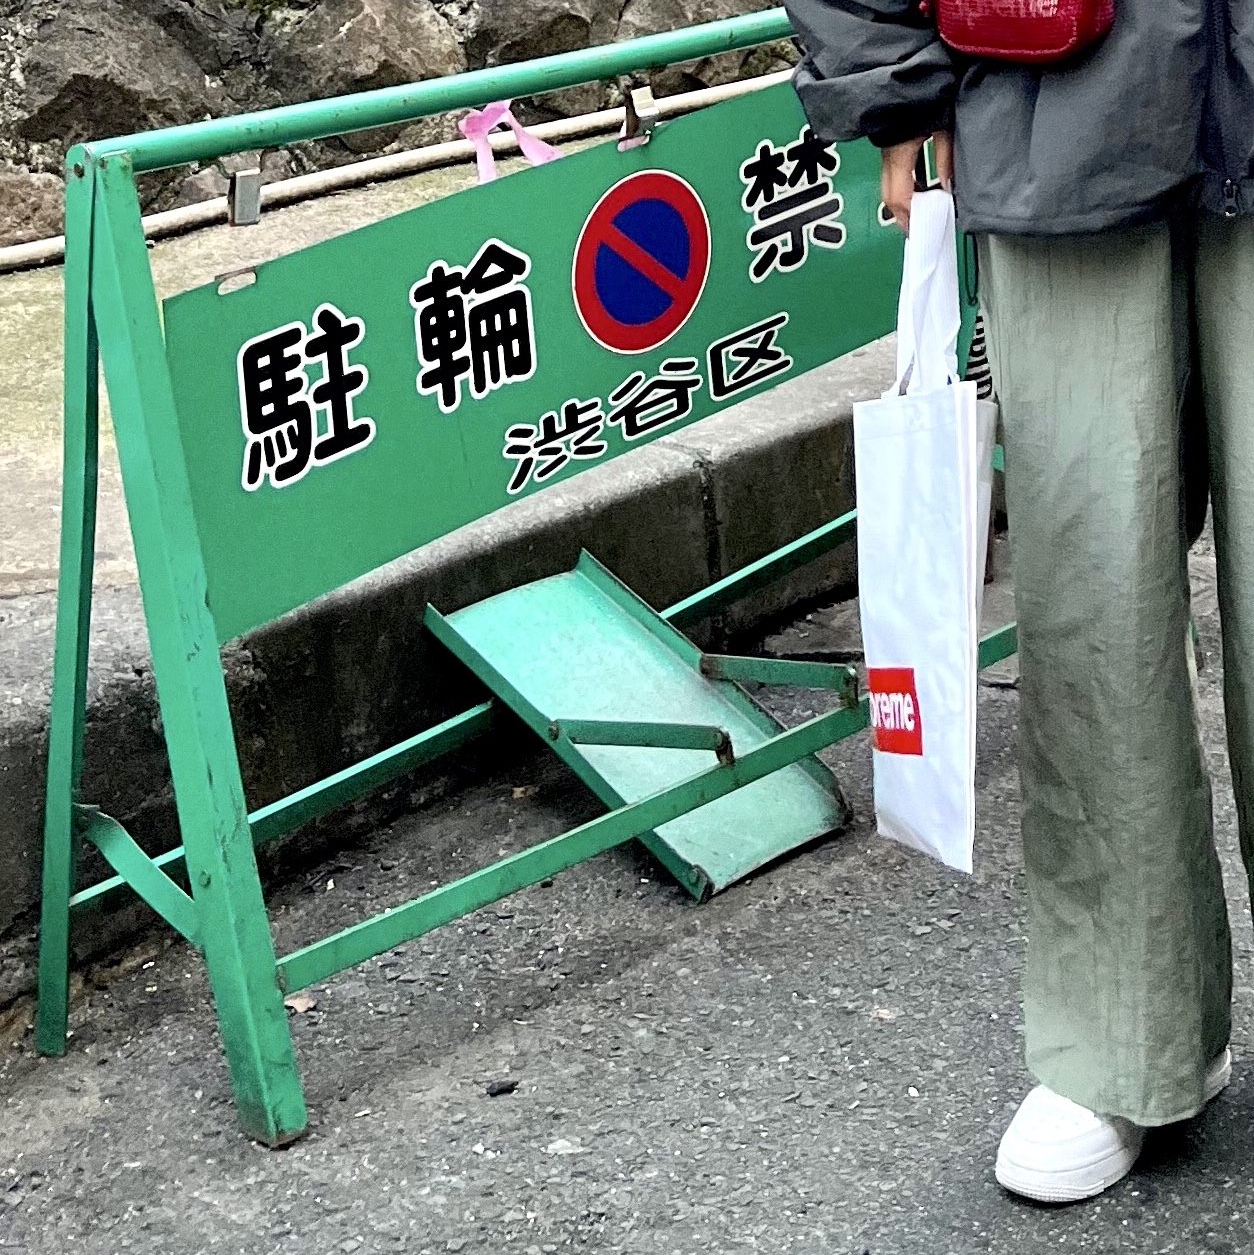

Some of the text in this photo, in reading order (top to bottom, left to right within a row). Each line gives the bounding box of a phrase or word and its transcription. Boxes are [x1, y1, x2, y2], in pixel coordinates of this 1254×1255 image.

[238, 126, 944, 493] 駐輪禁
[502, 311, 793, 496] 渋谷区
